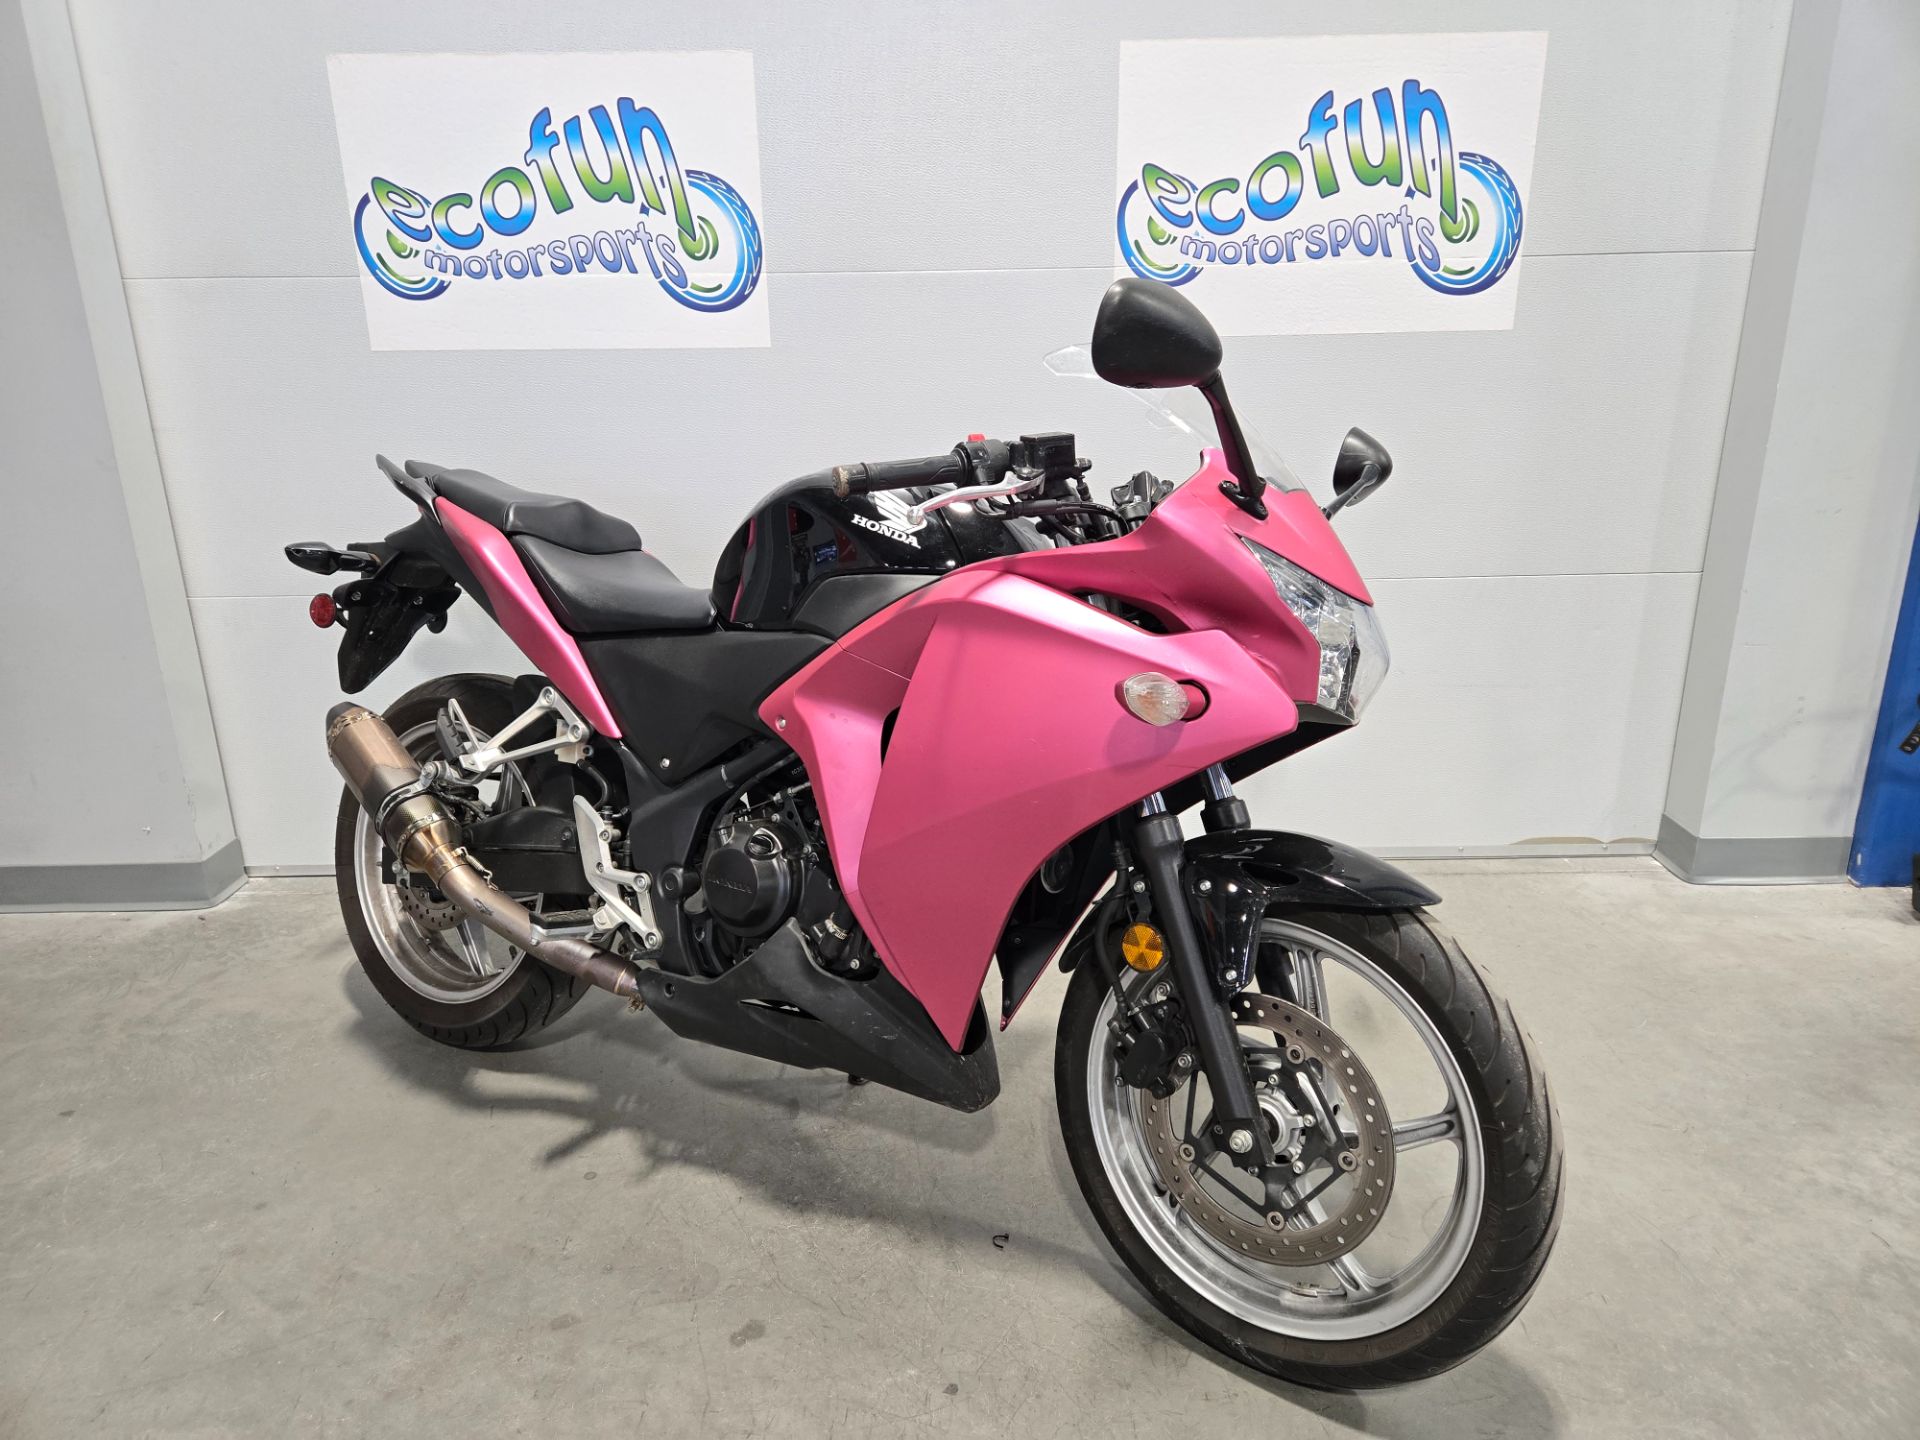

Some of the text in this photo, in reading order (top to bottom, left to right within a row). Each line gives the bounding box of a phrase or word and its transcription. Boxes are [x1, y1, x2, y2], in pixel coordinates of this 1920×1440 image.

[371, 96, 697, 250] ecofun
[1142, 79, 1458, 235] ecofun
[424, 221, 689, 289] motorsports
[1180, 204, 1441, 273] motorsports
[850, 513, 921, 549] HONDA
